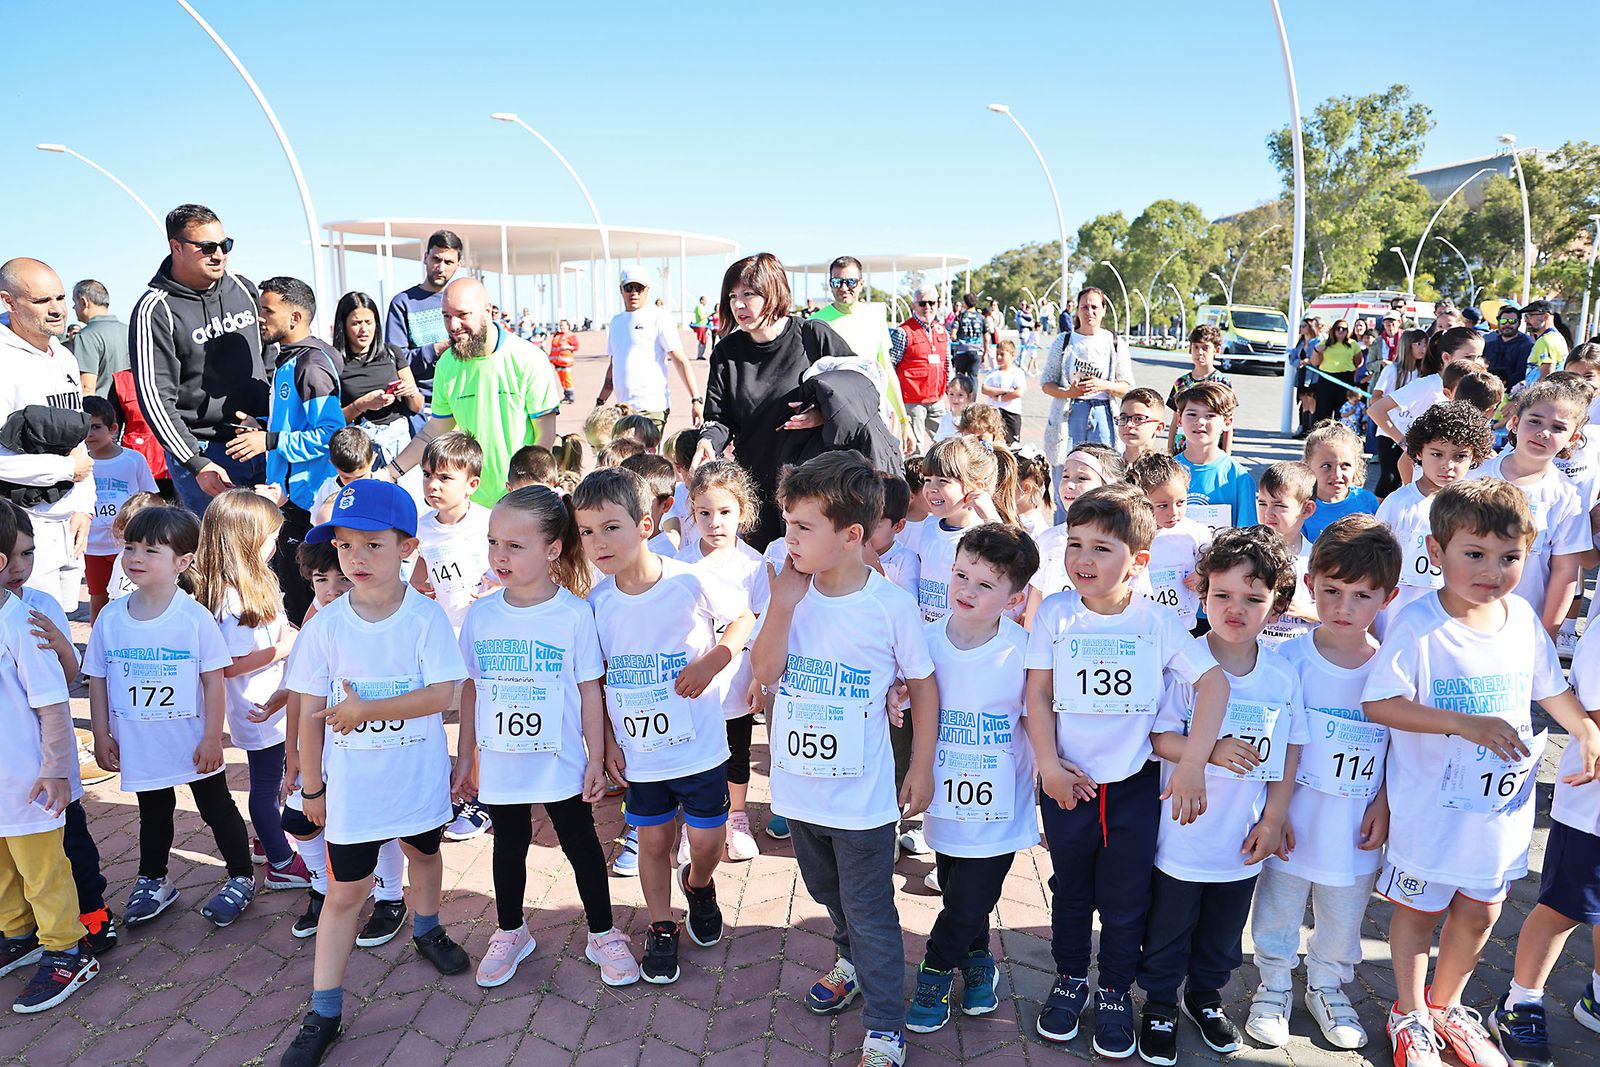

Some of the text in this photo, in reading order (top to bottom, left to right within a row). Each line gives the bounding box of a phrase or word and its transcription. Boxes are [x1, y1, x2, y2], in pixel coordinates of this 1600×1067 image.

[192, 310, 256, 345] adidas
[94, 504, 116, 517] 148
[432, 562, 462, 583] 141
[1151, 589, 1178, 606] 48
[1262, 630, 1292, 638] ATLANTIC
[536, 648, 563, 660] kilos
[1071, 640, 1078, 658] 9
[124, 662, 130, 677] 9
[535, 662, 542, 671] x
[546, 661, 562, 672] km
[608, 654, 687, 671] ARRERA kilos
[787, 654, 871, 685] RRERA kilos
[606, 670, 682, 686] NFANTIL x k
[1077, 669, 1132, 696] 138
[1433, 674, 1514, 696] CARRERA
[128, 686, 174, 706] 172
[492, 685, 498, 701] 9
[616, 692, 622, 708] 9
[839, 687, 846, 696] x
[850, 685, 870, 698] km
[788, 702, 793, 719] 9
[496, 712, 542, 736] 169
[624, 713, 669, 737] 070
[939, 709, 1010, 732] RERA kilos
[937, 726, 1011, 745] ANTIL x km
[1326, 721, 1335, 738] 9
[788, 731, 838, 760] 059
[1222, 734, 1271, 762] 70
[1476, 744, 1486, 761] 9
[939, 750, 945, 767] 9
[1333, 753, 1375, 780] 114
[943, 779, 993, 806] 106
[1053, 988, 1076, 999] Polo
[1100, 1003, 1124, 1011] Polo
